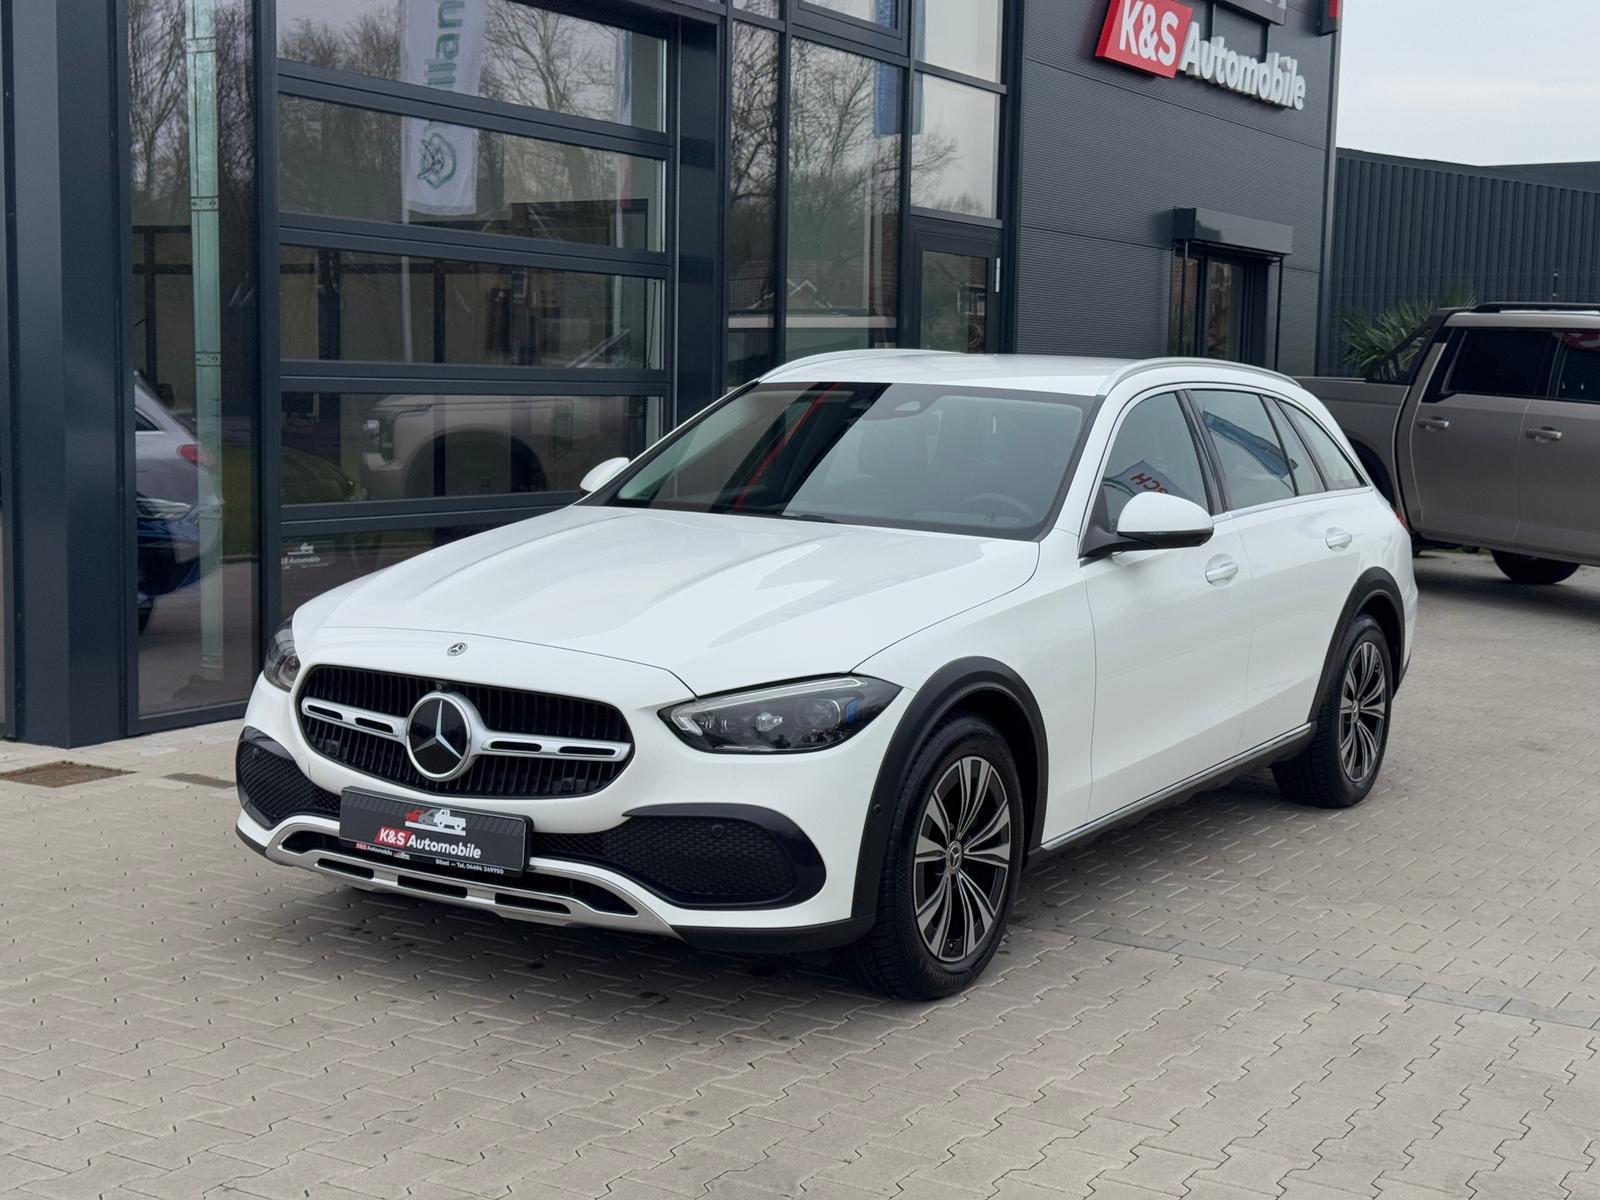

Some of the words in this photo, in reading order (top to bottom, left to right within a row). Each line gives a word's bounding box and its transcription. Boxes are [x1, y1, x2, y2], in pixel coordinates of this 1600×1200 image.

[1119, 0, 1179, 66] K&S
[1179, 21, 1306, 110] Automobile
[379, 828, 406, 846] K&S
[407, 834, 481, 858] Automobile
